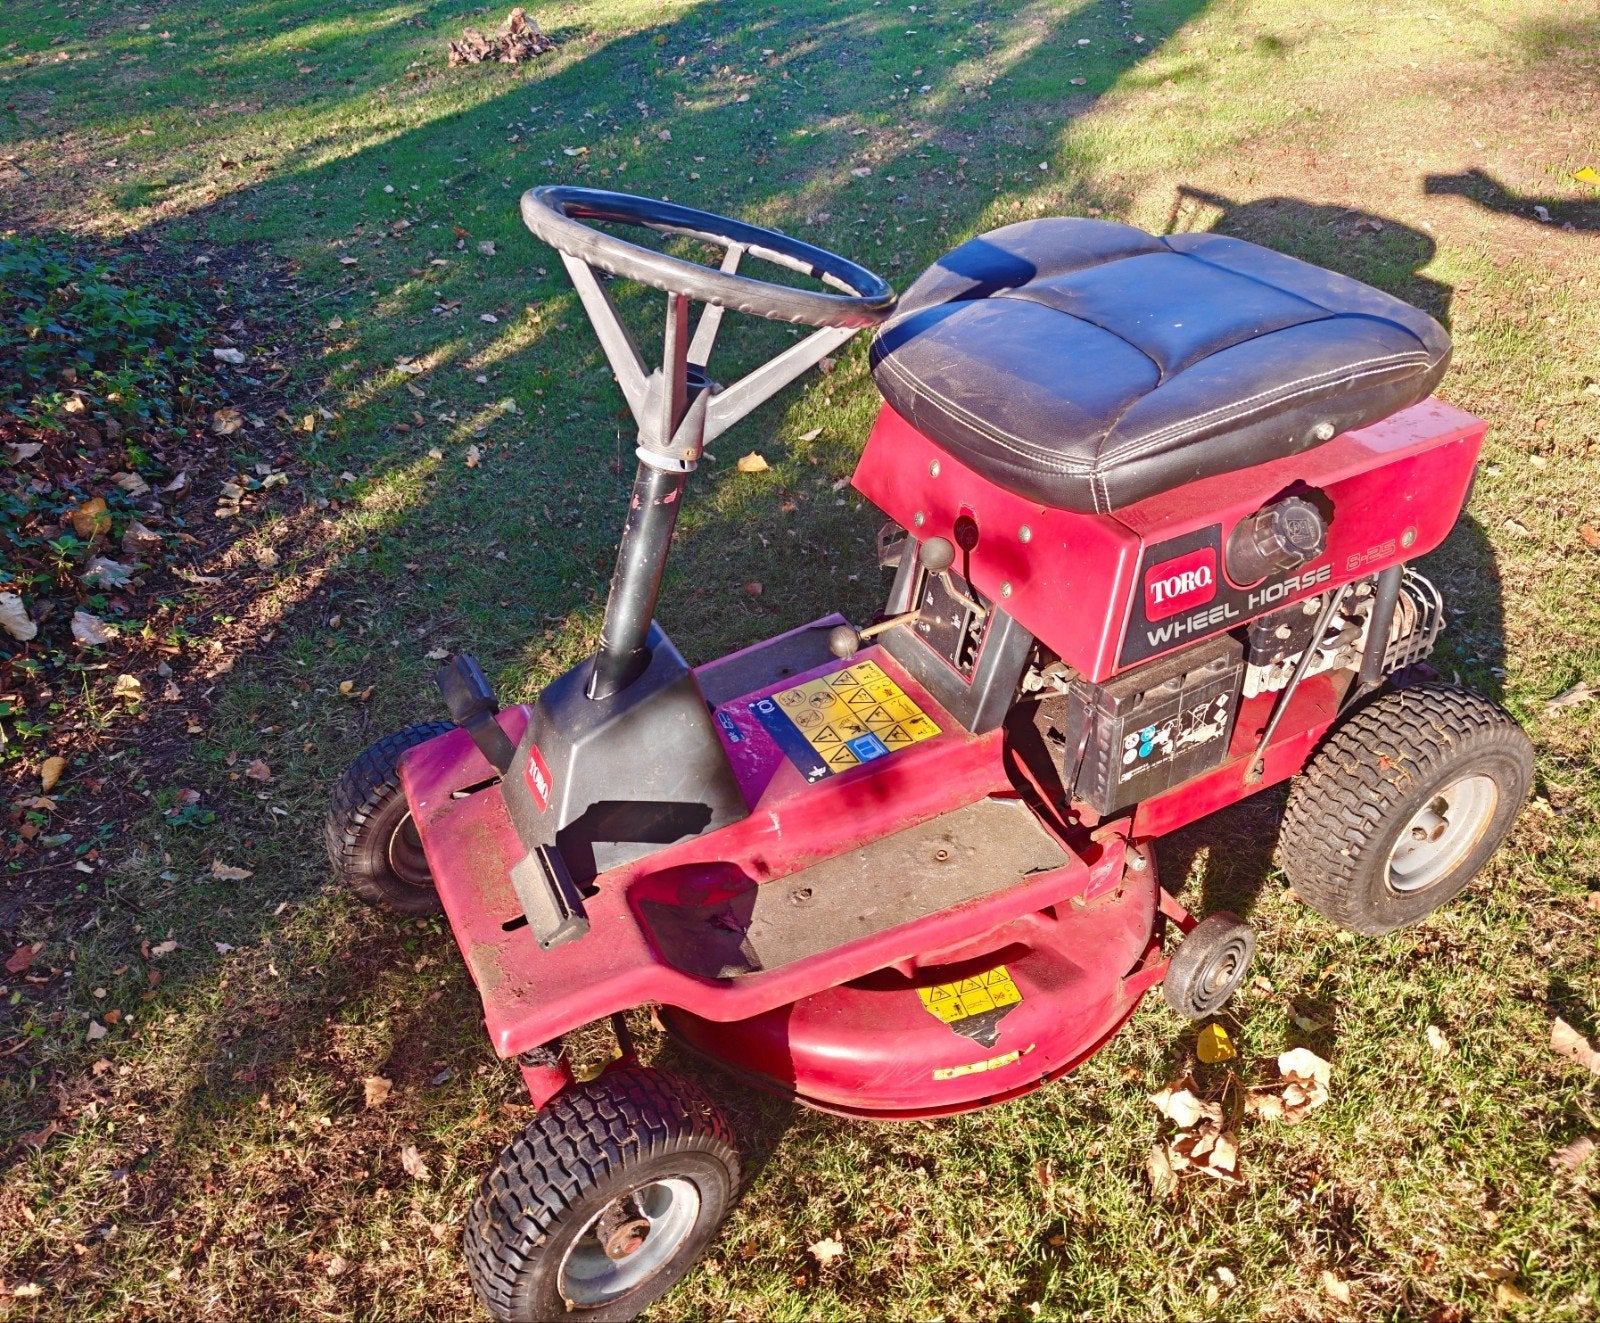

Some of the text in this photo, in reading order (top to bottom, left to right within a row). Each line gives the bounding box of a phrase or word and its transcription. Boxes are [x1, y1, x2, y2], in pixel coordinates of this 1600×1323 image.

[1147, 564, 1331, 647] WHEEL HORSE
[1150, 565, 1212, 604] TORO
[528, 756, 549, 804] TORO
